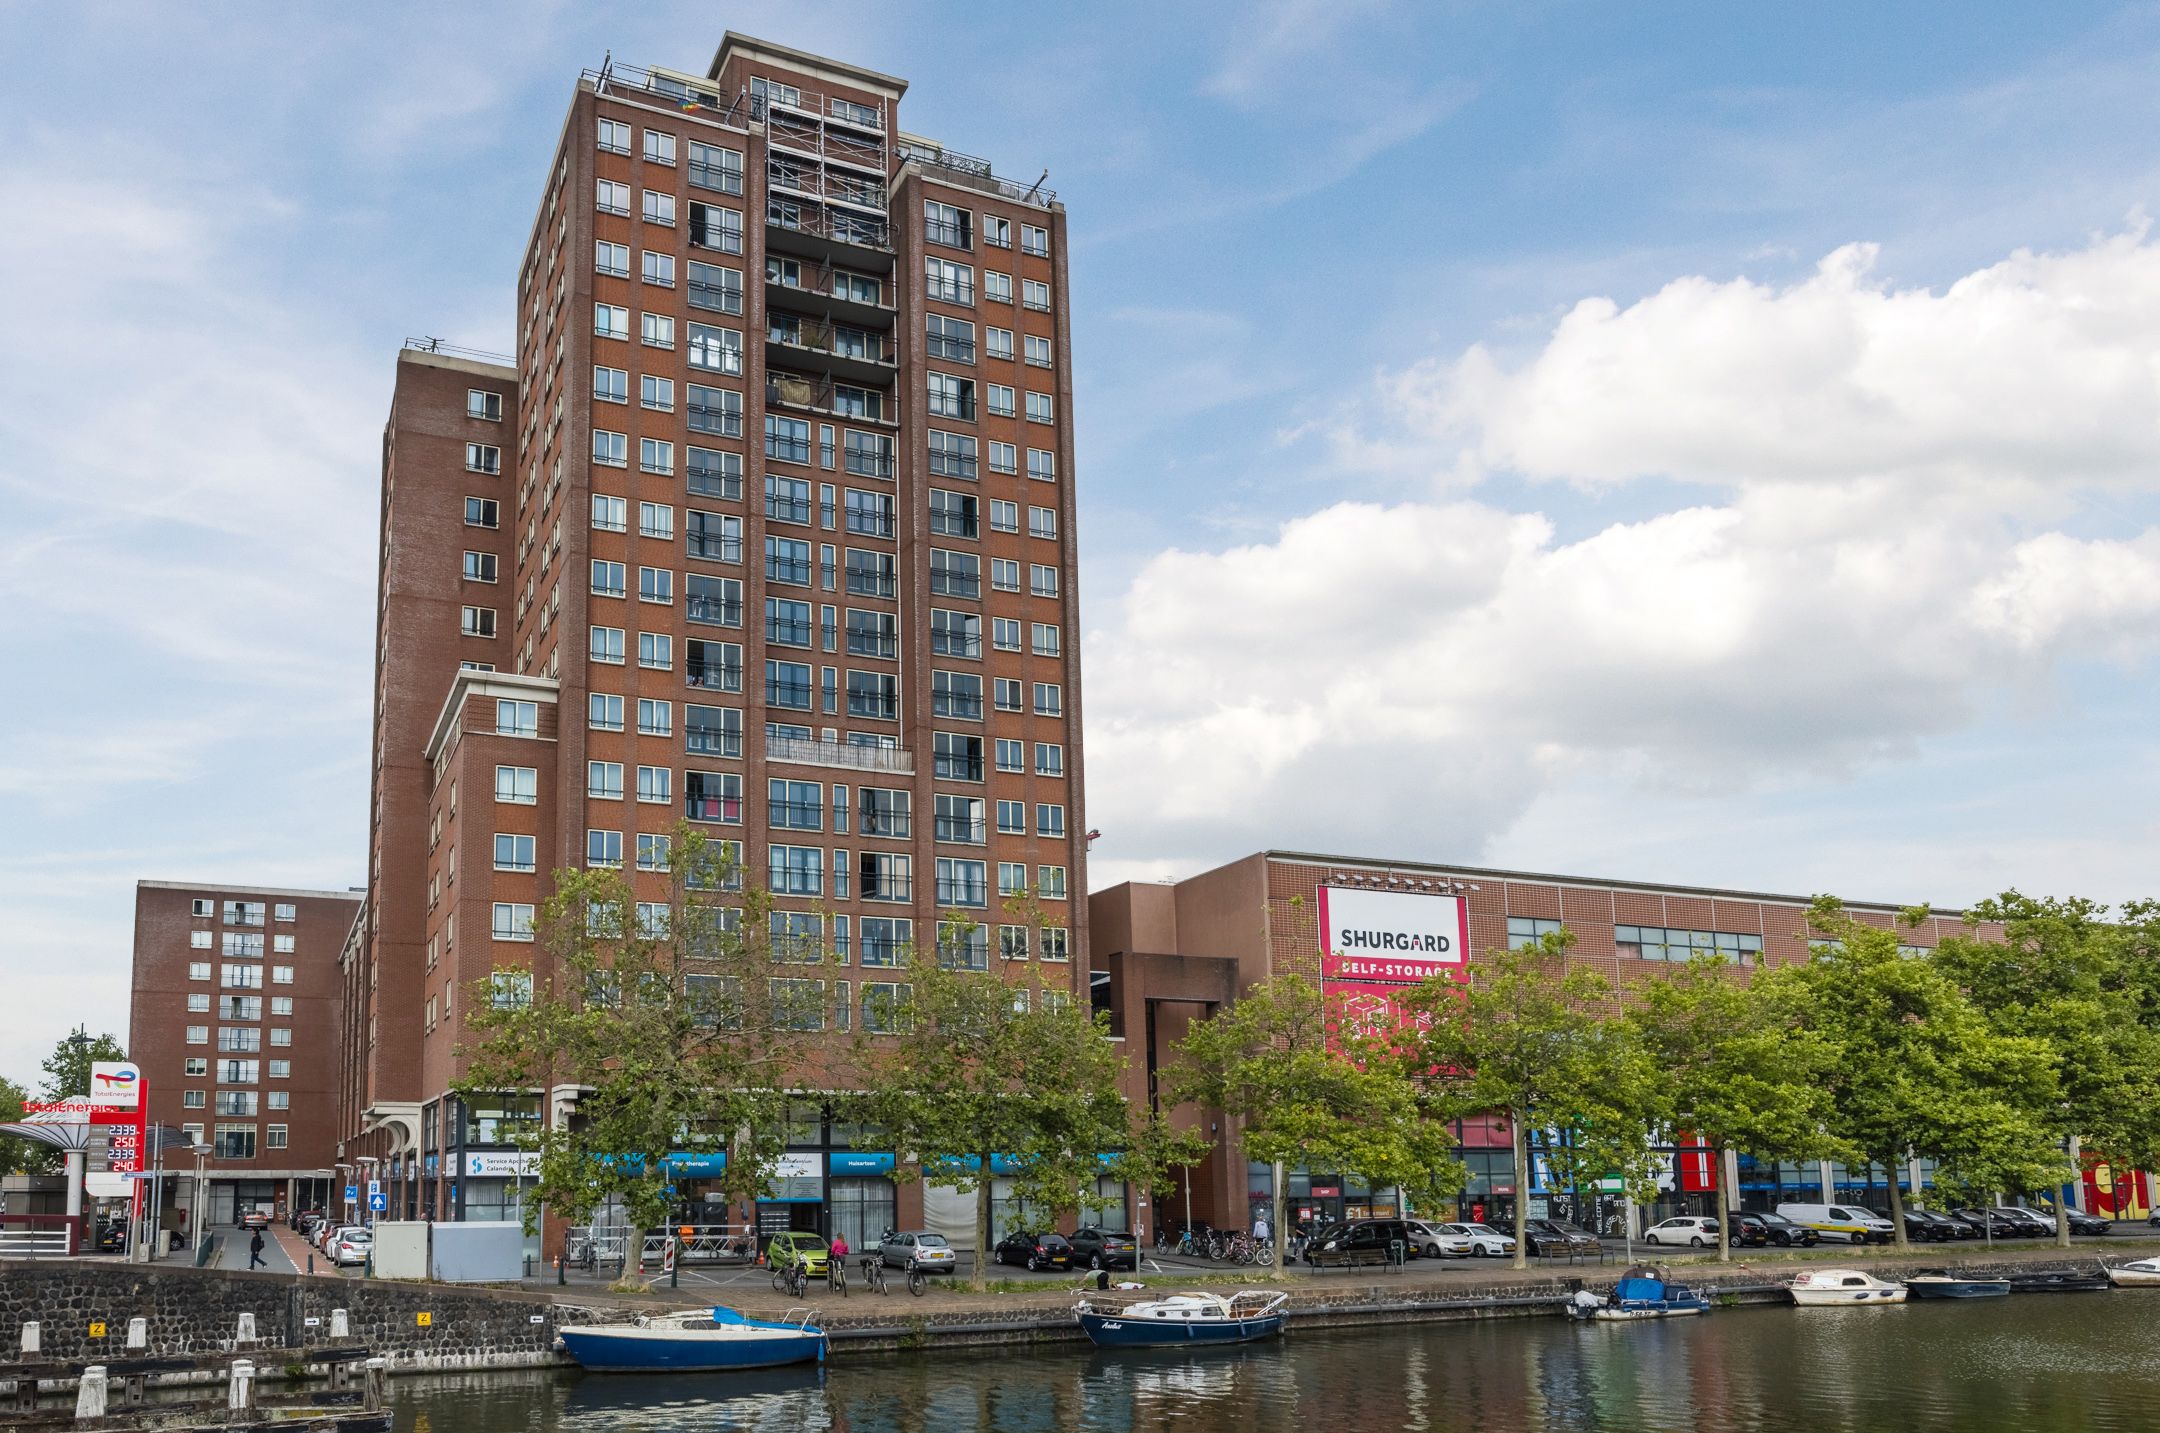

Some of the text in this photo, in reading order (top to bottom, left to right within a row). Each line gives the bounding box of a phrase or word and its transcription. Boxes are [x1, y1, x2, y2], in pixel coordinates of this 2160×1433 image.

[1341, 929, 1450, 952] SHURGARD
[1342, 961, 1452, 978] SELF-STORAGE
[20, 1101, 120, 1113] TotalEnergies
[113, 1161, 134, 1171] 240
[1595, 1196, 1603, 1234] WELCOME
[94, 1324, 101, 1332] Z
